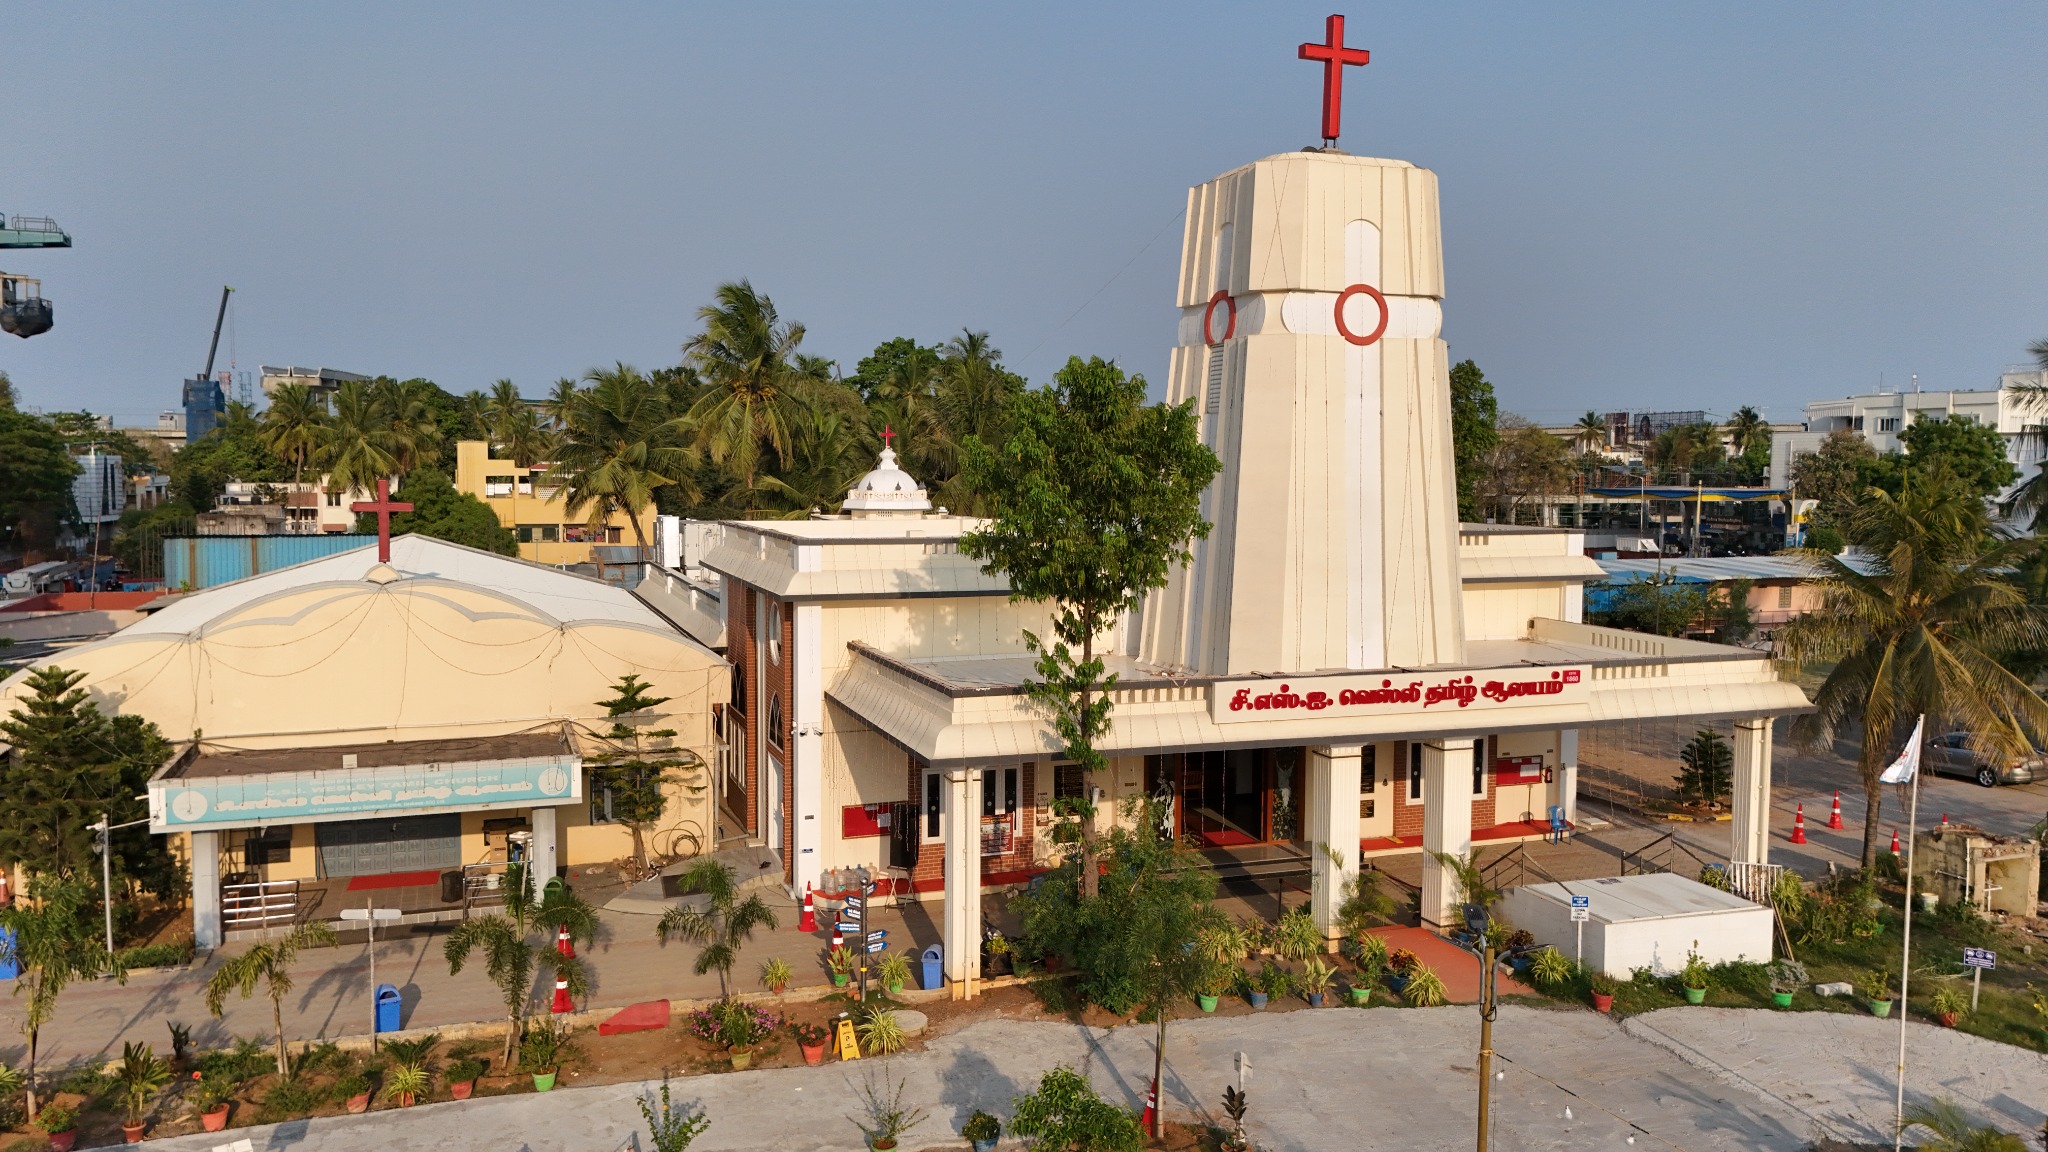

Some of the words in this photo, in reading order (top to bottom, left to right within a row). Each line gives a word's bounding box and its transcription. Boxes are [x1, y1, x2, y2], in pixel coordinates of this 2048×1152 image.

[1339, 679, 1423, 706] வெஸ்லி
[1423, 675, 1478, 708] தமிழ்
[1481, 671, 1564, 703] ஆலயம்
[311, 783, 376, 794] WESLEY
[381, 779, 430, 788] TAMIL
[434, 775, 499, 785] CHURCH
